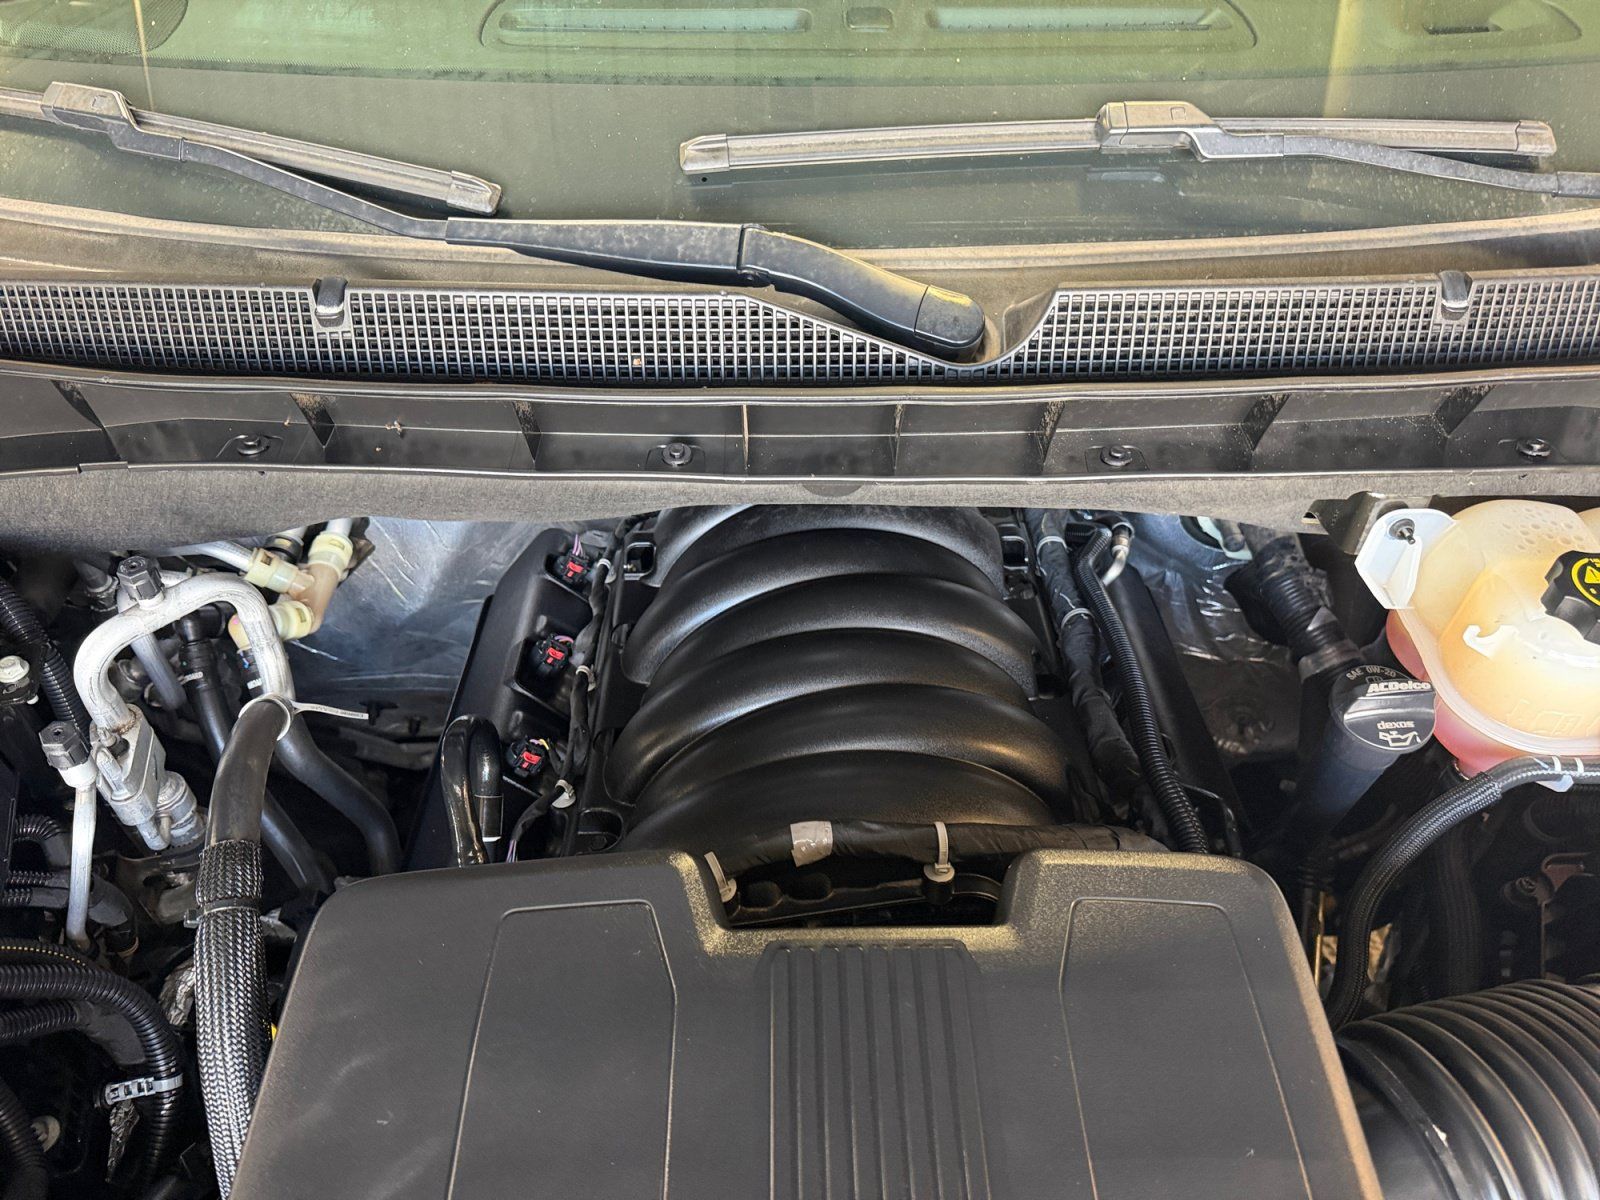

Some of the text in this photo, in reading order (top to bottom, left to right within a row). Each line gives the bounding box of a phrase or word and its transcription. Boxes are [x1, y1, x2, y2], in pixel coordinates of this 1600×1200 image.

[1346, 665, 1396, 680] SAE 0W-20
[1367, 680, 1432, 693] ACDelco
[1377, 720, 1415, 729] dexos
